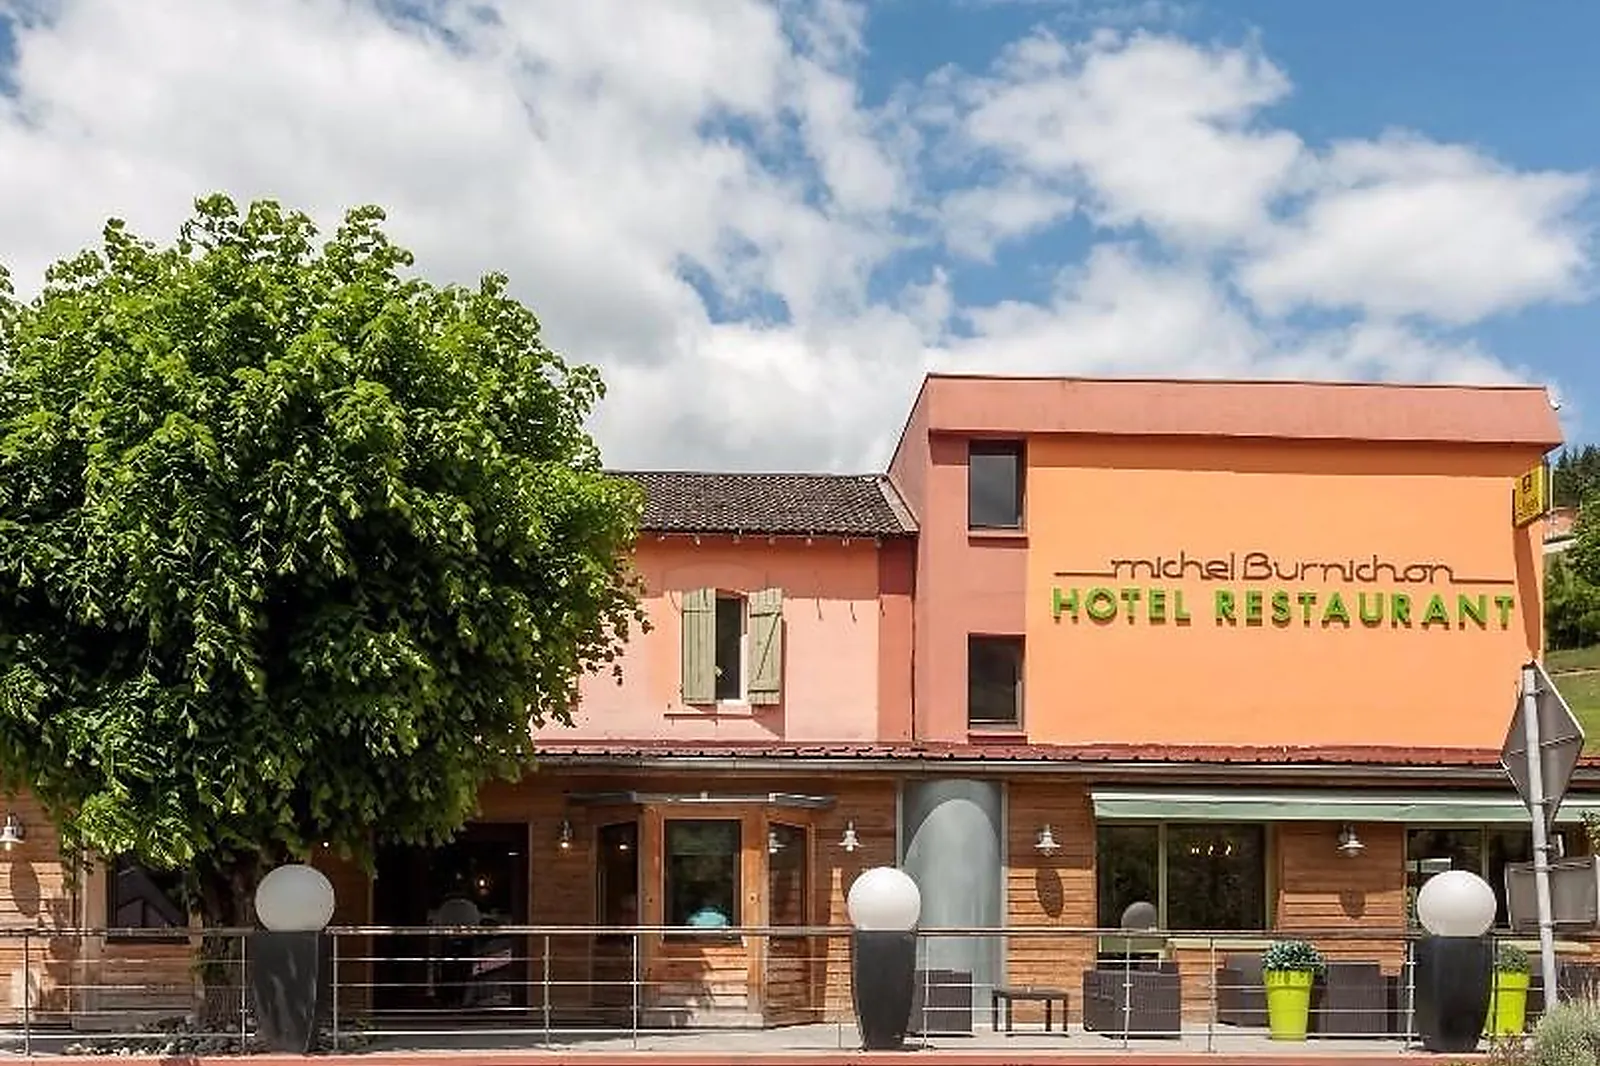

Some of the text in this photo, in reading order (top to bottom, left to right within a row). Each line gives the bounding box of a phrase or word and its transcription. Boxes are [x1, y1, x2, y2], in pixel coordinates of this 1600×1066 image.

[1242, 552, 1455, 584] Burnichon
[1053, 588, 1515, 630] HOTEL RESTAURANT
